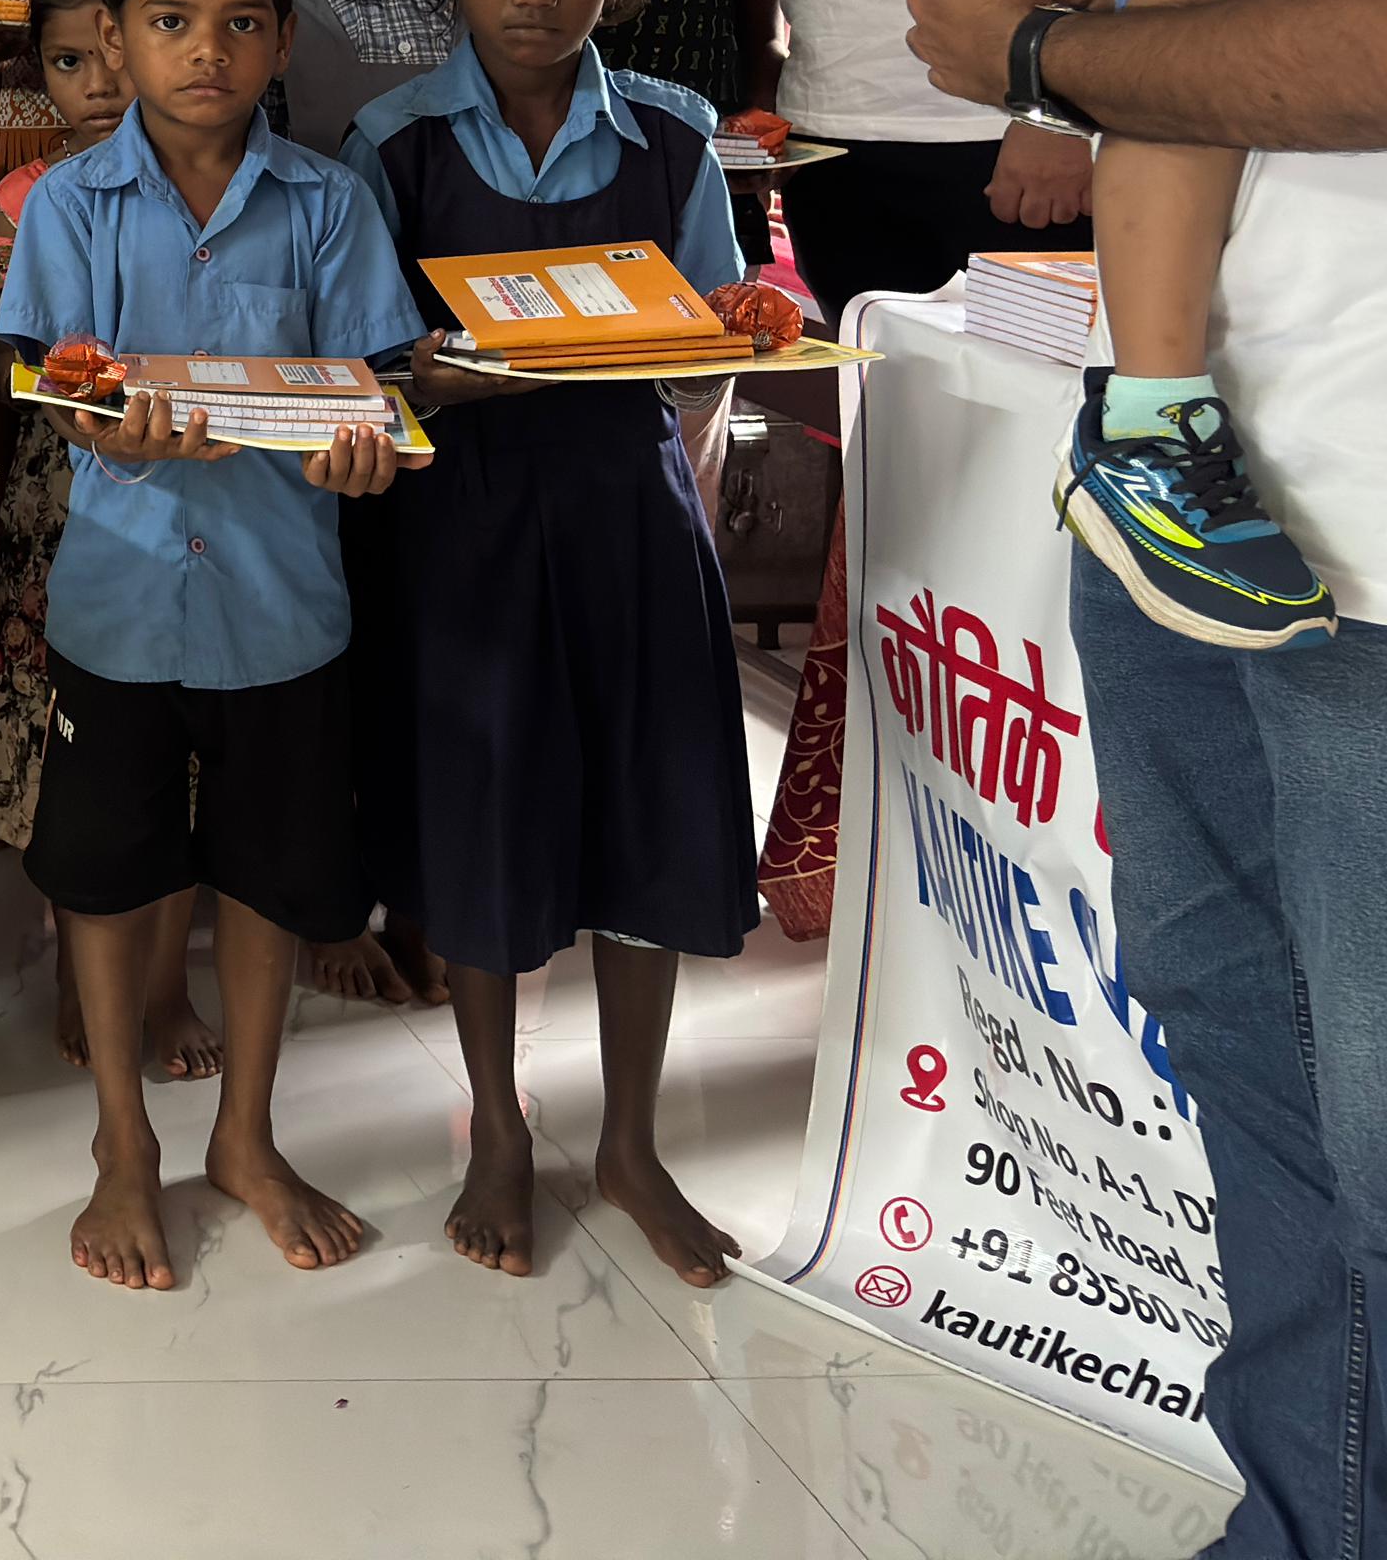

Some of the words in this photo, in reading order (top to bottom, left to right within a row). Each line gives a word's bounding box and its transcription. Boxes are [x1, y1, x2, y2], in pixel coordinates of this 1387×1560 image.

[876, 587, 1082, 828] कौतिके
[901, 760, 1078, 1026] KAUTIKE
[957, 964, 1043, 1087] Regd.
[965, 1142, 1021, 1196] 90
[1026, 1165, 1092, 1242] Feet
[1089, 1211, 1208, 1300] Road,
[974, 1067, 1032, 1150] Shop
[1030, 1117, 1090, 1184] No.
[1095, 1155, 1175, 1228] A-1,
[950, 1227, 1034, 1284] +91
[1049, 1252, 1181, 1334] 83560
